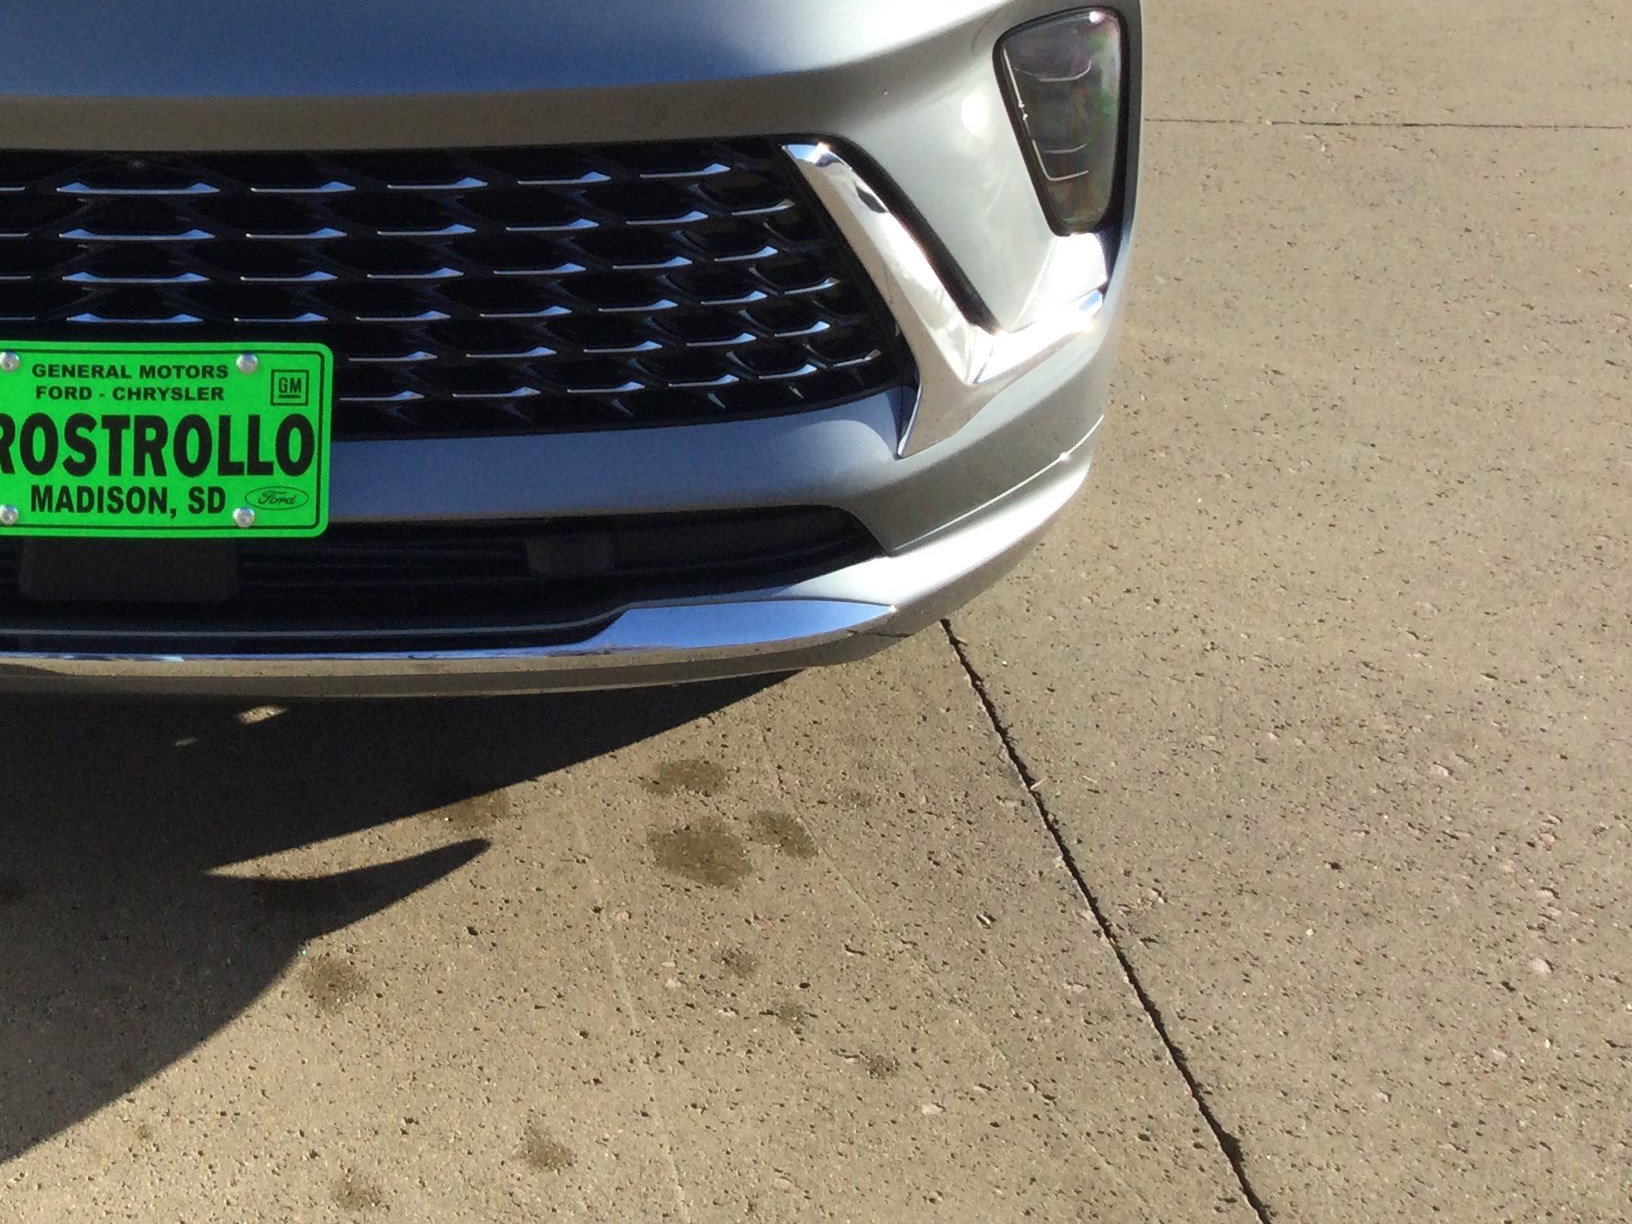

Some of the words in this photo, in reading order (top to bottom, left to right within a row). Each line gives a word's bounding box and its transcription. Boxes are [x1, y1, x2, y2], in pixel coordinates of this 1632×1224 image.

[32, 363, 133, 380] GENERAL
[139, 364, 229, 380] MOTORS
[35, 385, 93, 401] FORD
[111, 386, 225, 402] CHRYSLER
[277, 376, 303, 394] GM
[30, 484, 178, 519] MADISON,
[187, 485, 227, 515] SD
[257, 489, 298, 506] Ford
